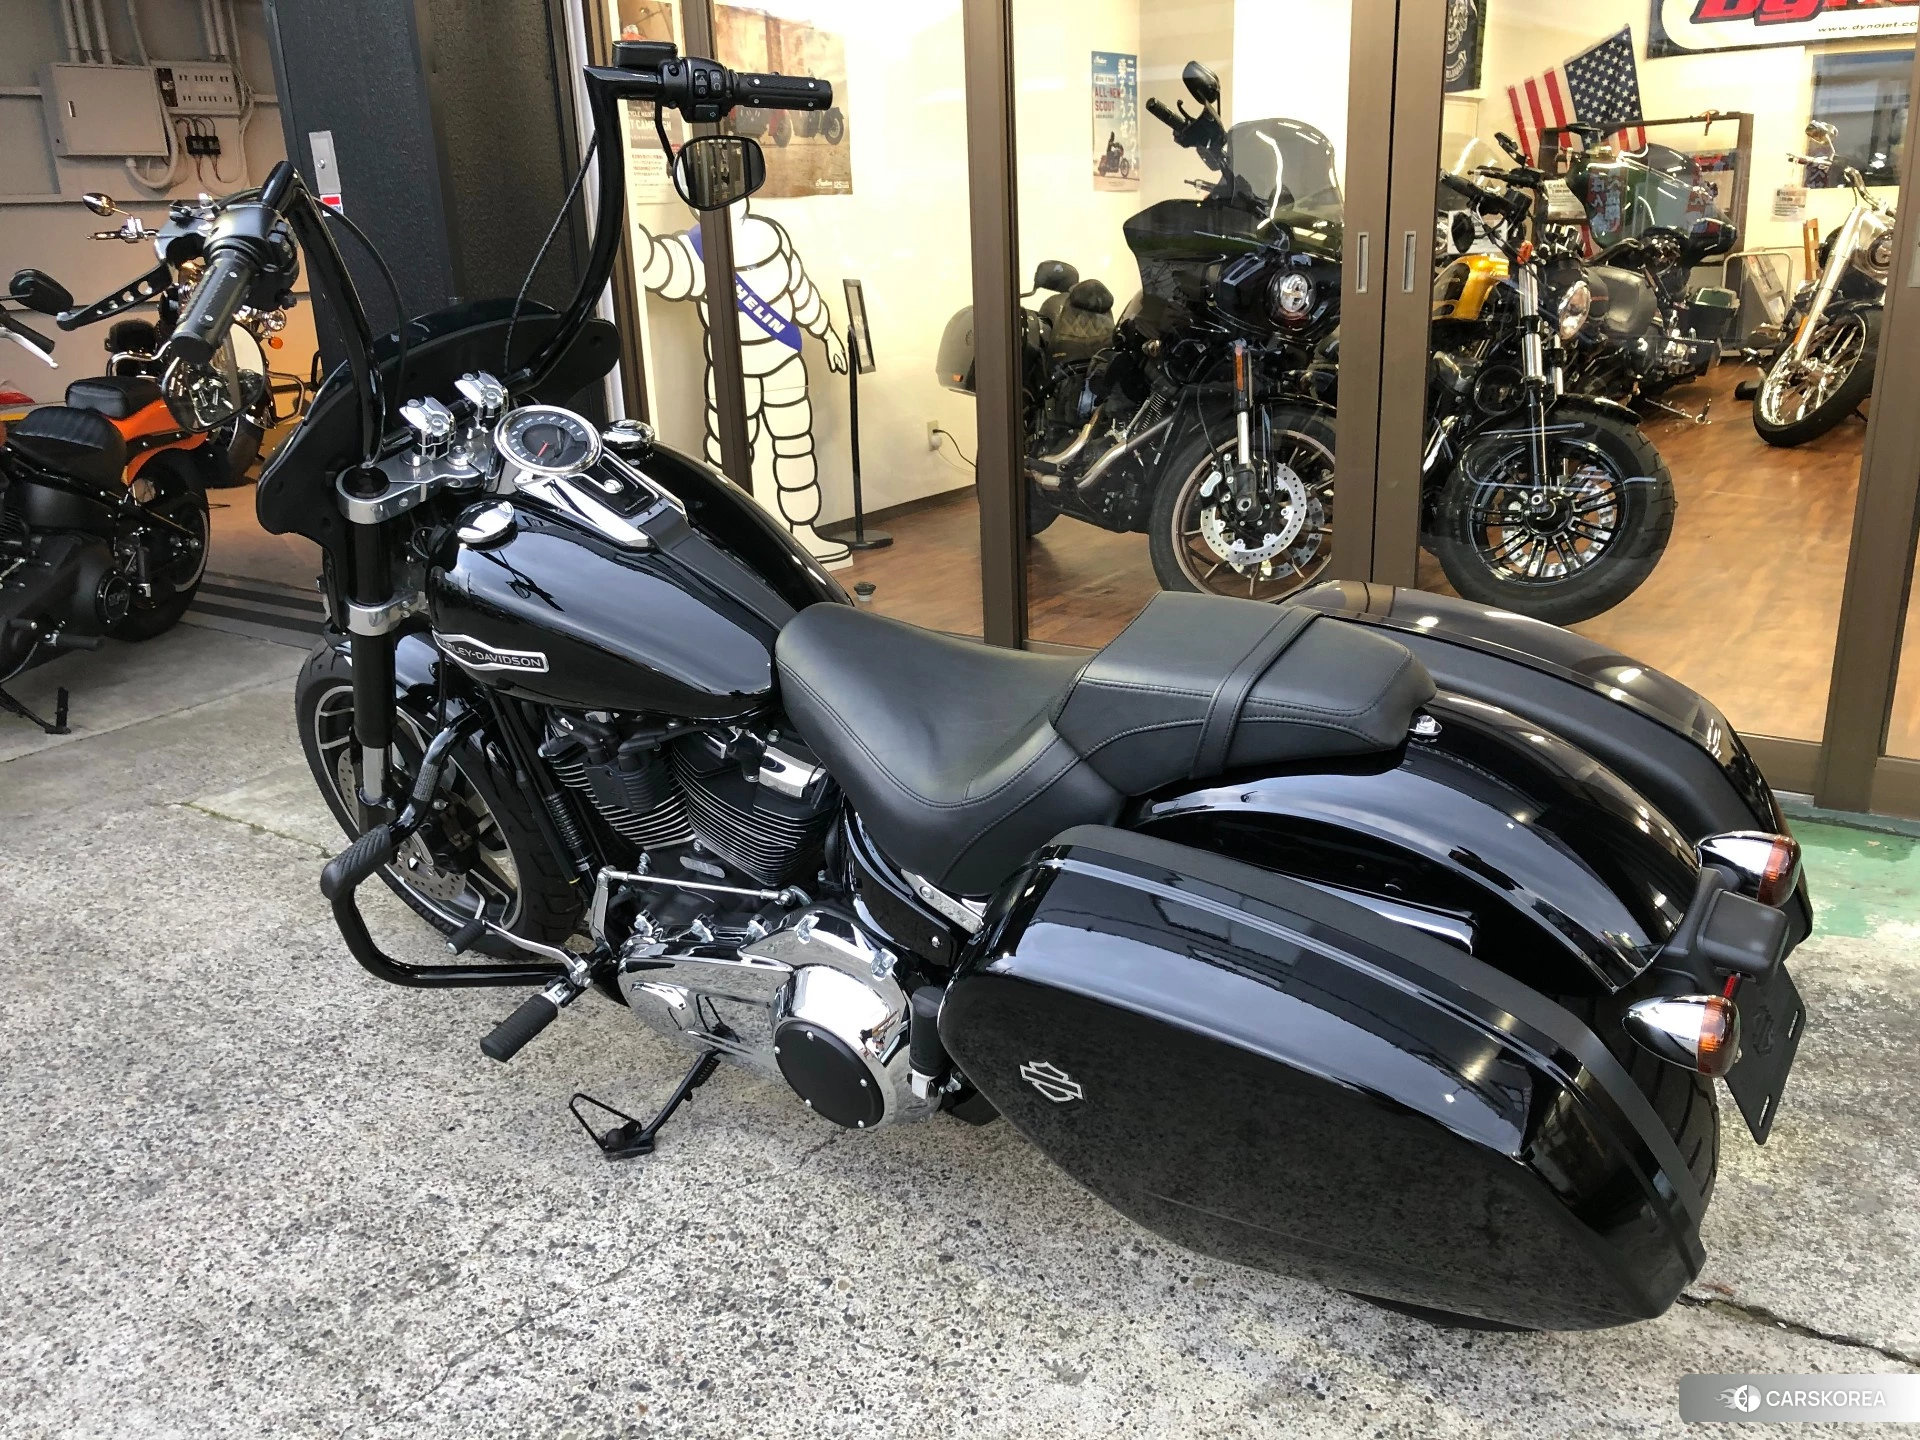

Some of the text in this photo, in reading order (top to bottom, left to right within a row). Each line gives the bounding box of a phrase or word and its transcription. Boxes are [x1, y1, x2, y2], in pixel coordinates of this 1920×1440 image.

[1818, 21, 1917, 31] www.dynojet.co
[1095, 100, 1115, 112] SCOUT
[636, 119, 672, 131] CAMPGN
[736, 279, 786, 334] HELIN
